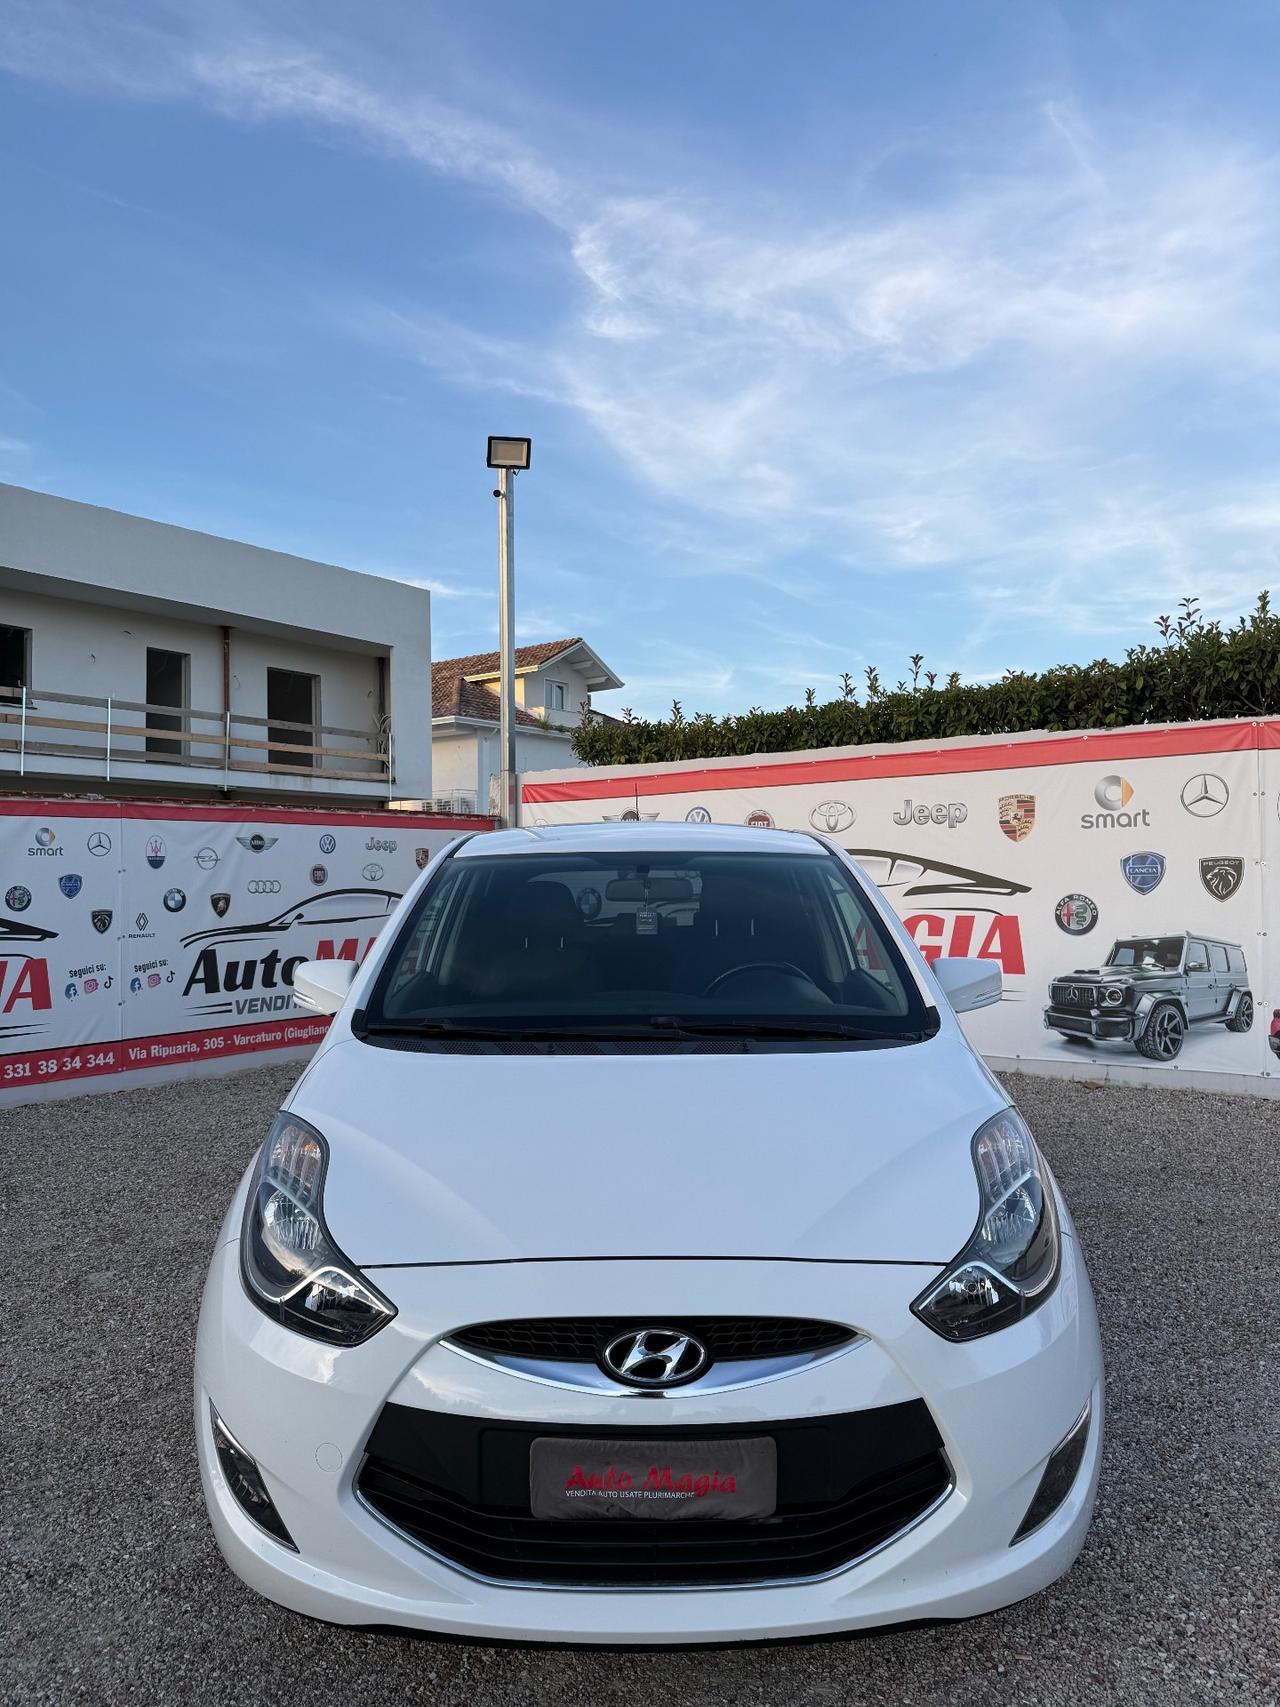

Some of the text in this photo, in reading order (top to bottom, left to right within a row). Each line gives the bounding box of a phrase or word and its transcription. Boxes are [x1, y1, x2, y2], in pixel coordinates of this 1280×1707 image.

[892, 799, 968, 828] Jeep
[1080, 809, 1150, 829] smart
[27, 846, 63, 856] smart
[365, 837, 398, 854] Jeep
[1130, 867, 1159, 875] LANCIA
[1056, 894, 1097, 916] ALFA ROMEO
[69, 963, 106, 979] Seguici su:
[134, 958, 169, 973] Seguici su:
[4, 1062, 32, 1079] 331
[37, 1059, 58, 1075] 38
[62, 1055, 82, 1071] 34
[86, 1051, 115, 1068] 344
[128, 1048, 147, 1061] Via
[151, 1041, 200, 1058] Ripuaria,
[203, 1038, 225, 1051] 305
[233, 1031, 281, 1046] Varcaturo
[565, 1463, 737, 1498] Auto Magia
[565, 1489, 597, 1498] VENDITA
[597, 1490, 618, 1498] AUTO
[619, 1491, 642, 1499] USATE
